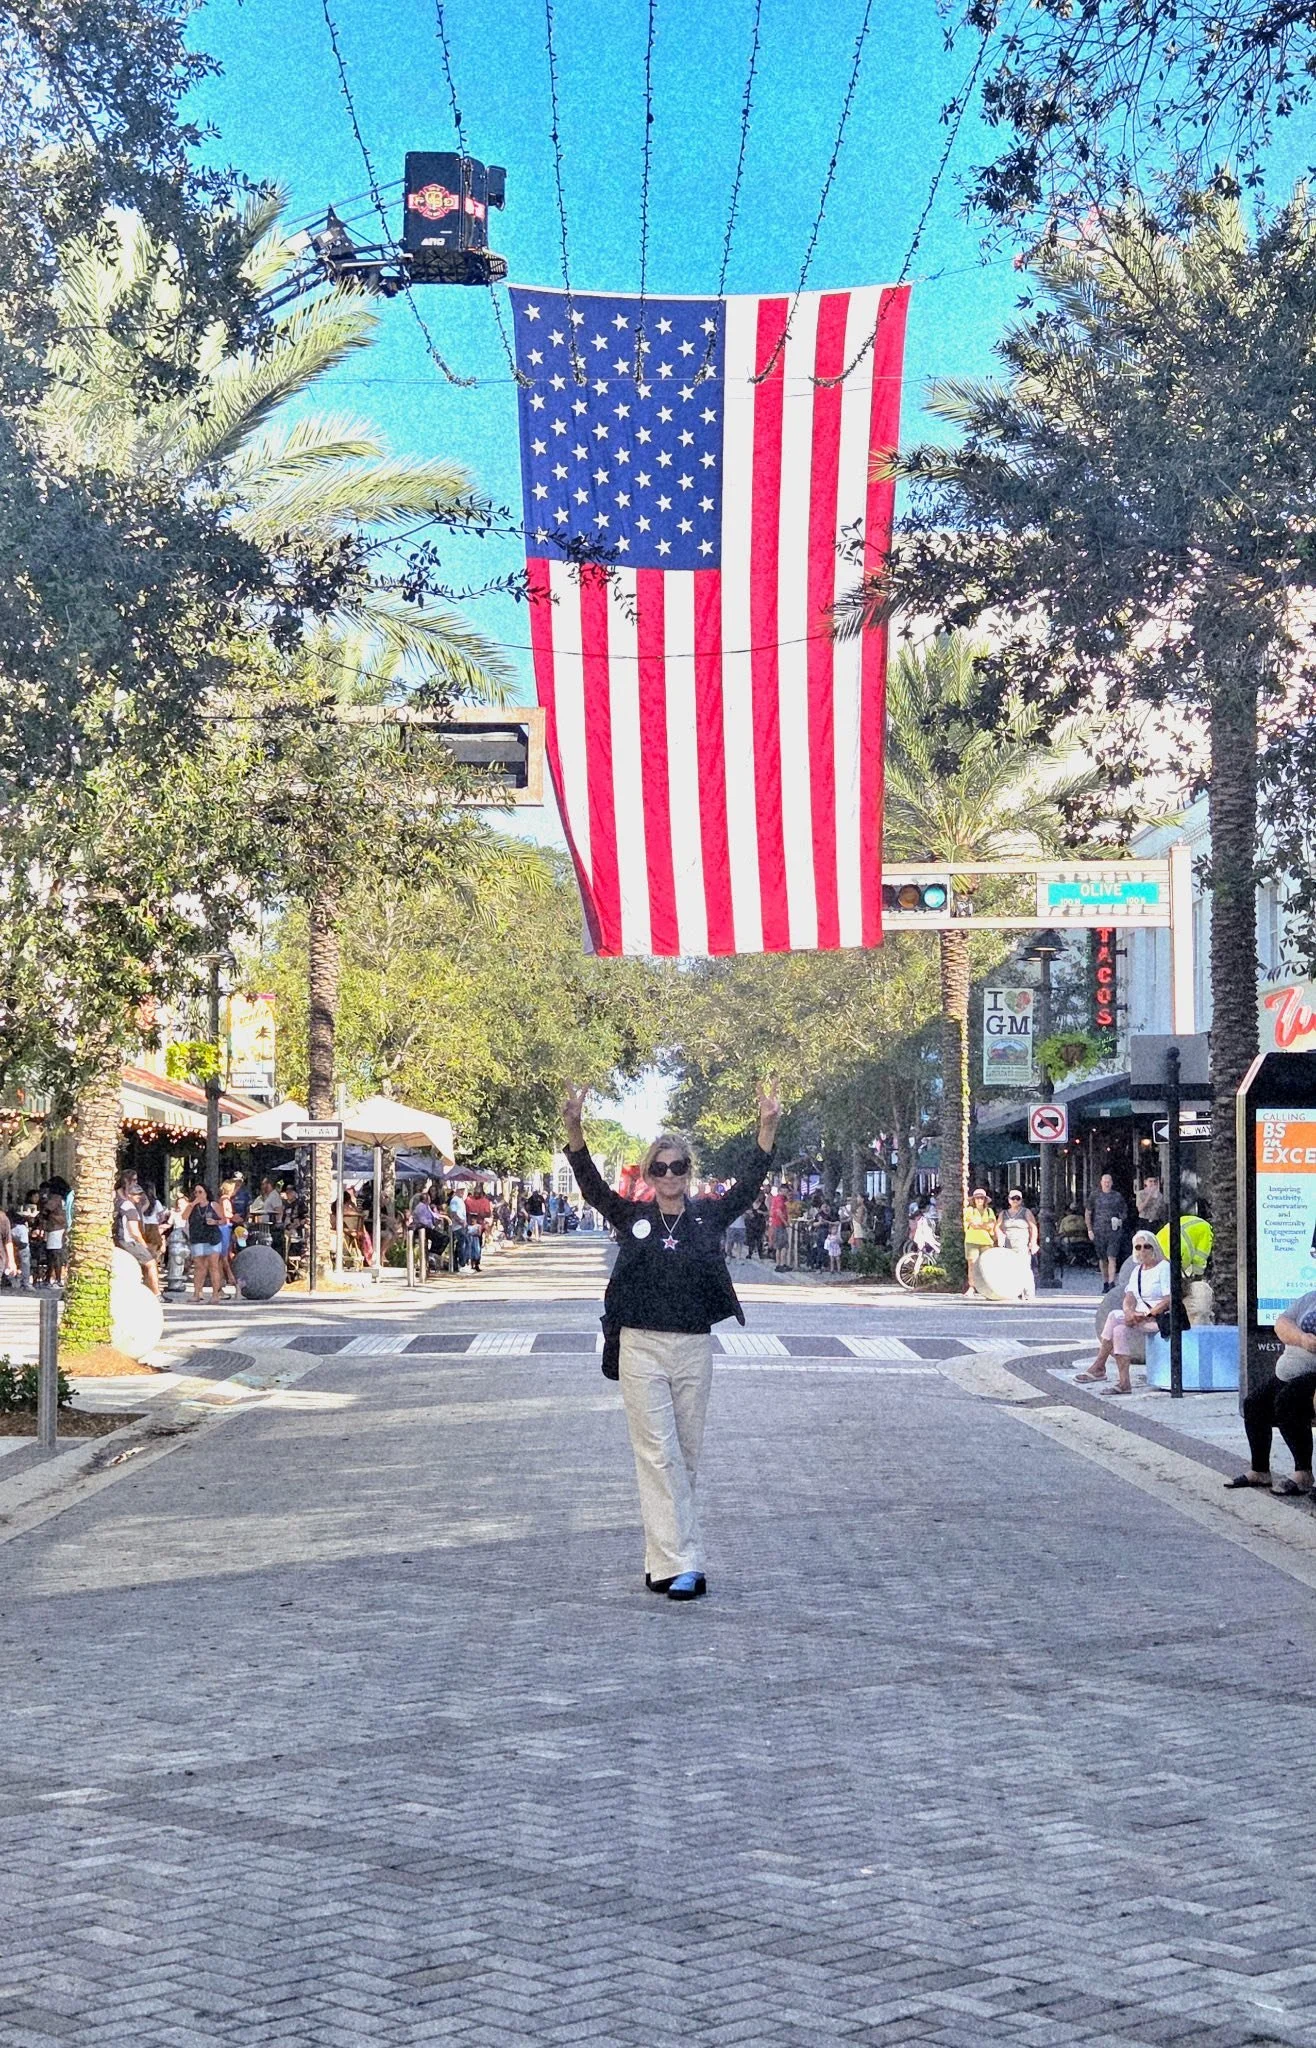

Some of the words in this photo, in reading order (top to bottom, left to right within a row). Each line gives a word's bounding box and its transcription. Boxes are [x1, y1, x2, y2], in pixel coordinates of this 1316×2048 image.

[1080, 883, 1122, 897] OLIVE
[987, 991, 1003, 1011] I
[986, 1015, 1030, 1035] GM
[1263, 1112, 1305, 1121] CALLING
[1263, 1122, 1286, 1138] BS
[1263, 1147, 1316, 1164] EXCE
[1269, 1186, 1301, 1194] Inspiring
[1263, 1228, 1306, 1236] Engagement
[1257, 1343, 1281, 1352] WEST
